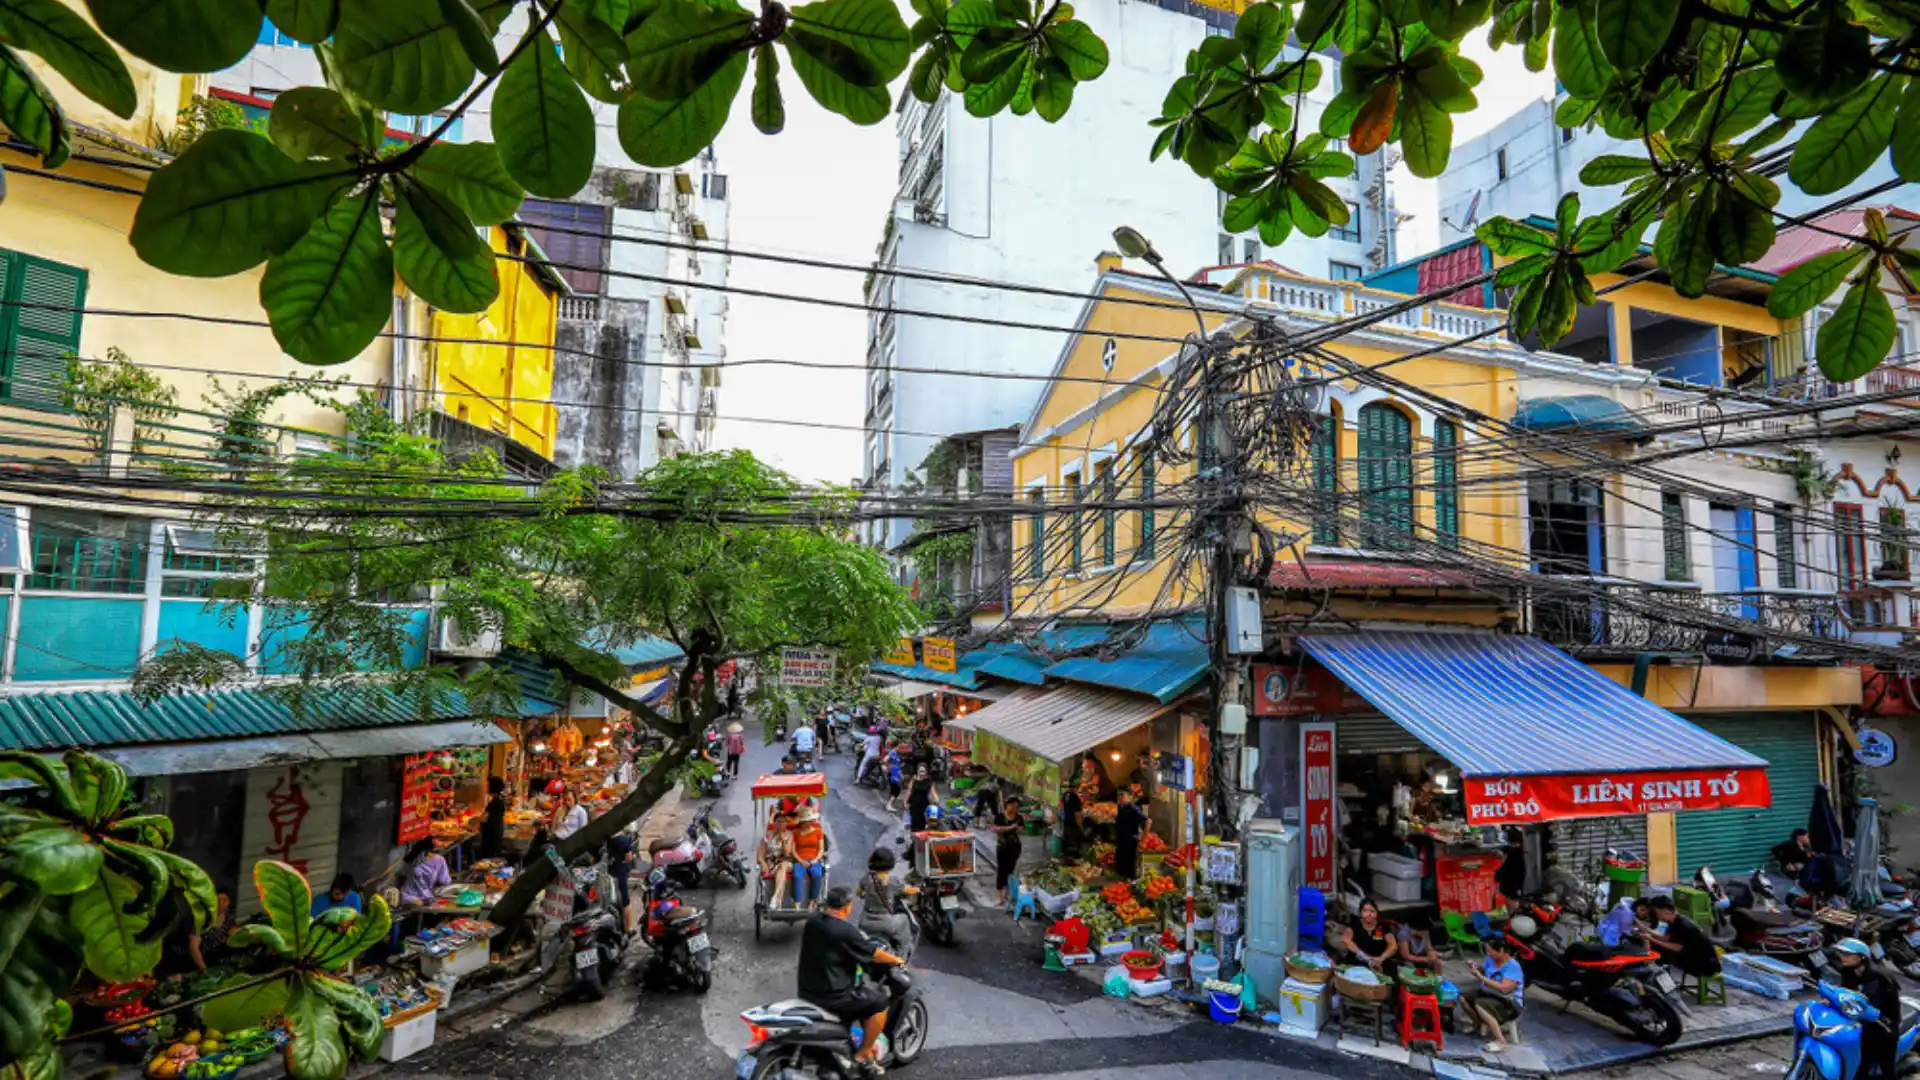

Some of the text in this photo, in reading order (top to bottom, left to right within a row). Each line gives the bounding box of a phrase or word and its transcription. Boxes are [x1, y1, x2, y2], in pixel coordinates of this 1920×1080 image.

[1484, 779, 1522, 796] BÚN
[1572, 770, 1740, 804] LIÊN SINH TỐ
[1471, 799, 1509, 818] PHÚ
[1310, 807, 1328, 858] TỐ
